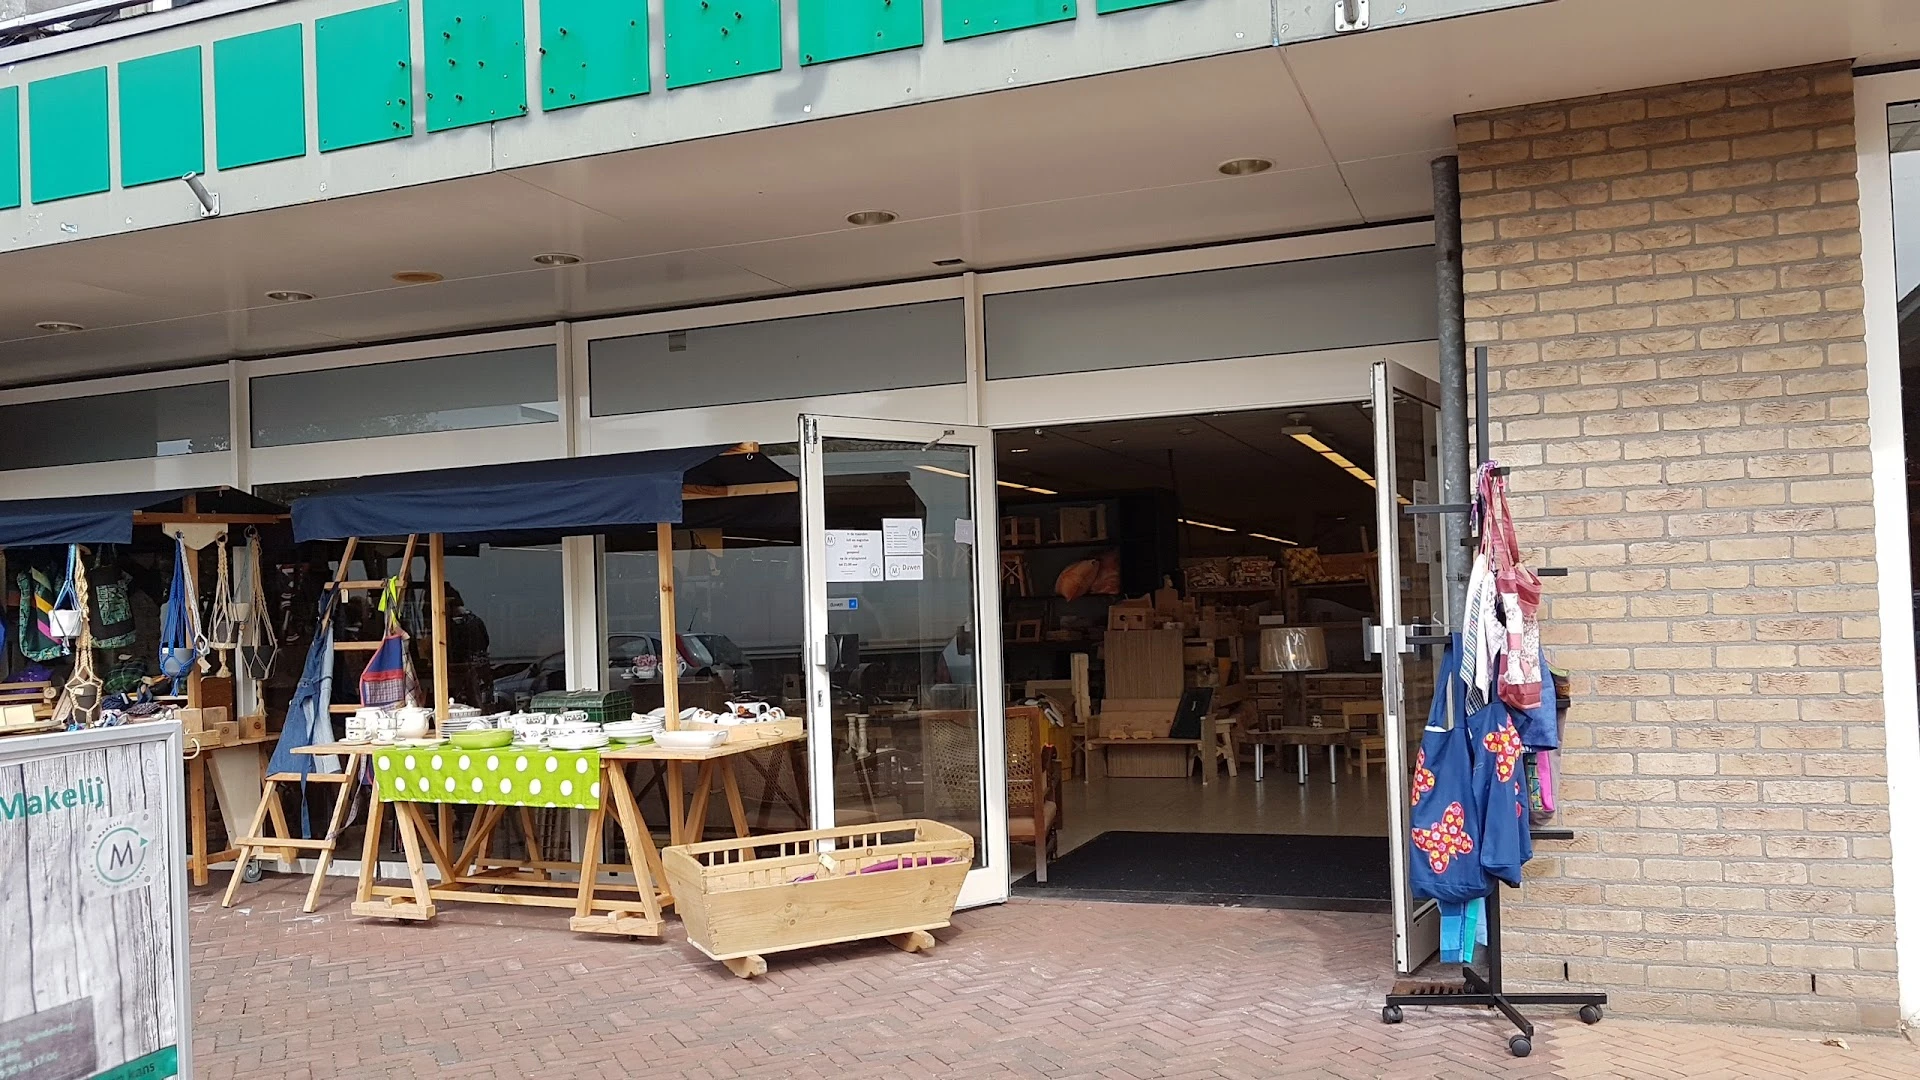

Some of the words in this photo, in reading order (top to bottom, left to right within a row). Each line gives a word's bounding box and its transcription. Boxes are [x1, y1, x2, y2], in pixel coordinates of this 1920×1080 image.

[0, 776, 104, 822] Makelij
[109, 839, 134, 871] M
[127, 1062, 156, 1078] kans
